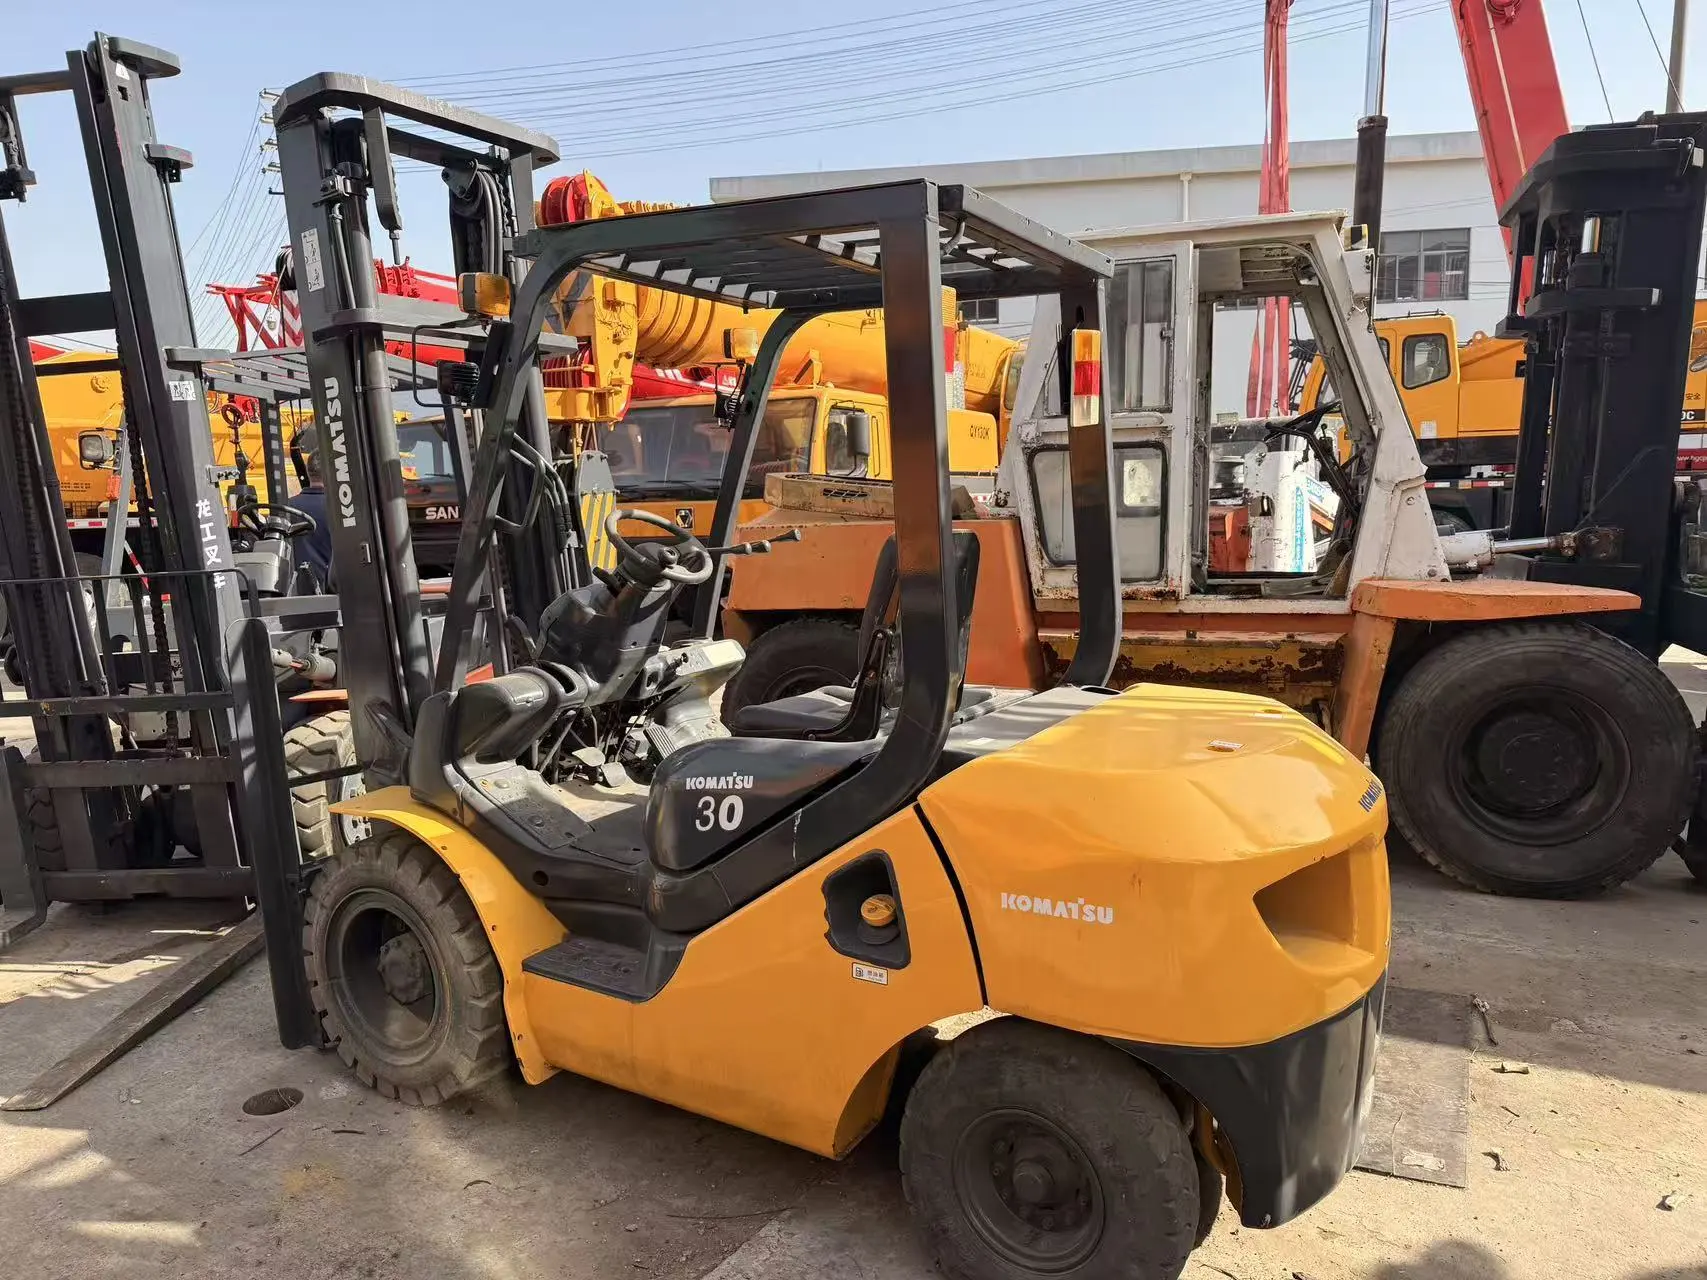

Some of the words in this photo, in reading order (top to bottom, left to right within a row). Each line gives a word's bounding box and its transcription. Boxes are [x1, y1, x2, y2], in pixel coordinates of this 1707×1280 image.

[324, 377, 356, 528] KOMATSU
[425, 505, 460, 520] SAN
[685, 771, 754, 790] KOMATSU
[695, 794, 744, 832] 30
[1000, 892, 1114, 924] KOMATSU
